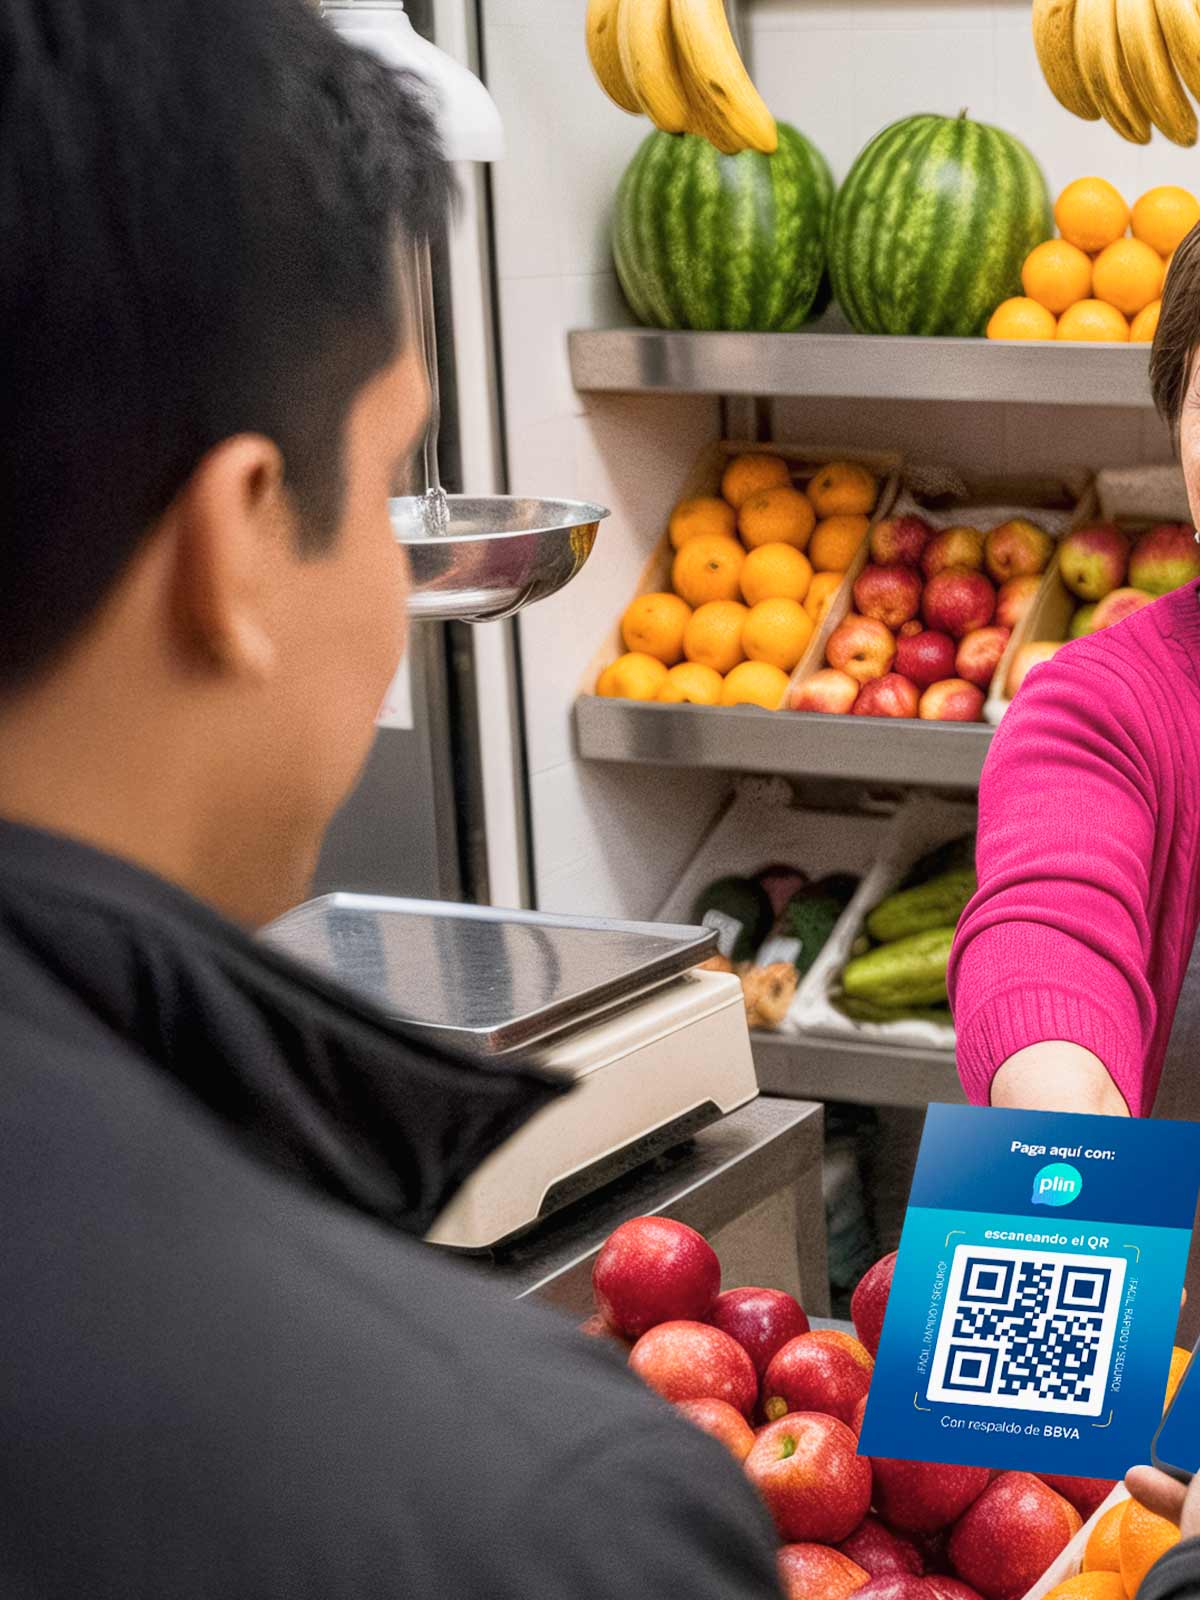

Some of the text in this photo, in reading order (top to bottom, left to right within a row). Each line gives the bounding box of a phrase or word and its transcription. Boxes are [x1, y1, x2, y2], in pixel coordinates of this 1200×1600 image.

[1010, 1141, 1116, 1160] Paga aquí con:
[1039, 1176, 1075, 1194] plin
[984, 1230, 1110, 1250] escaneando el QR
[940, 1415, 1080, 1439] Con respaldo de BBVA
